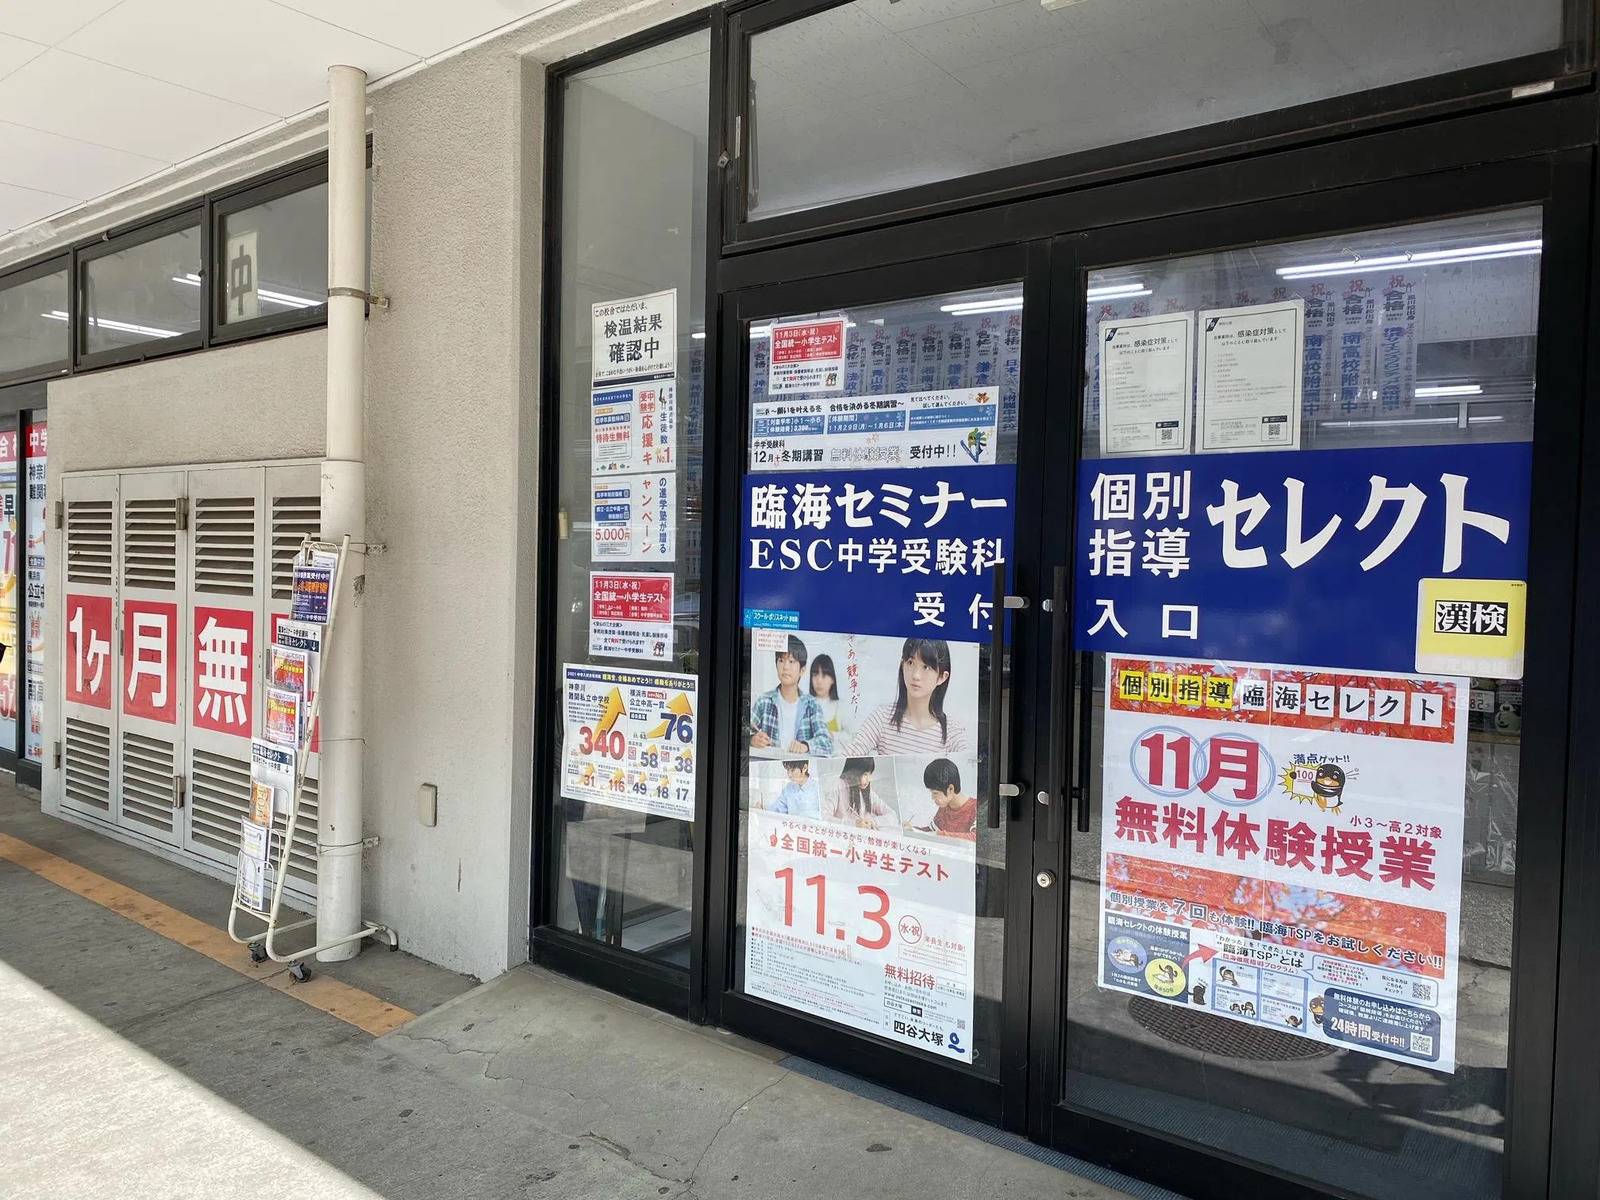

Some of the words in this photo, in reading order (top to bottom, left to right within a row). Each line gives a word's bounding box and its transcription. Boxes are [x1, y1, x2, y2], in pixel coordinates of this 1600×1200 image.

[231, 244, 252, 316] 中
[604, 313, 662, 338] 検温結果
[609, 337, 660, 364] 確認中
[775, 335, 838, 348] 全国統一小学生テスト
[754, 440, 785, 450] 中学受験科
[751, 481, 1008, 530] 臨海セミナー
[1090, 470, 1192, 521] 個別
[1205, 473, 1510, 573] セレクト
[749, 538, 1005, 576] ESC中学受験科
[1089, 528, 1191, 578] 指導
[594, 591, 666, 604] 全国統一小学生テスト
[1087, 598, 1199, 640] 入口
[1436, 601, 1507, 635] 漢検
[128, 611, 168, 708] 月
[198, 616, 248, 727] 無
[630, 698, 665, 709] 公立中高一貫
[1121, 672, 1232, 708] 個別指導
[1242, 677, 1436, 723] 臨海セレクト
[579, 726, 625, 760] 340
[661, 713, 693, 743] 76
[640, 751, 658, 768] 58
[675, 756, 693, 773] 38
[1140, 733, 1260, 802] 11月
[583, 775, 595, 786] 31
[632, 782, 647, 795] 49
[656, 786, 669, 799] 18
[676, 787, 689, 801] 17
[1114, 795, 1438, 892] 無料体験授業
[781, 833, 951, 886] 全国統一小学生テスト
[775, 866, 891, 950] 11.3
[1107, 916, 1188, 940] 臨海セレクトの体験授業
[884, 963, 936, 990] 無料招待
[1333, 993, 1431, 1021] 無料体験のお申し込みはこちらから
[894, 1020, 944, 1047] 四谷大塚
[1330, 1016, 1405, 1048] 24時間受付中!!
